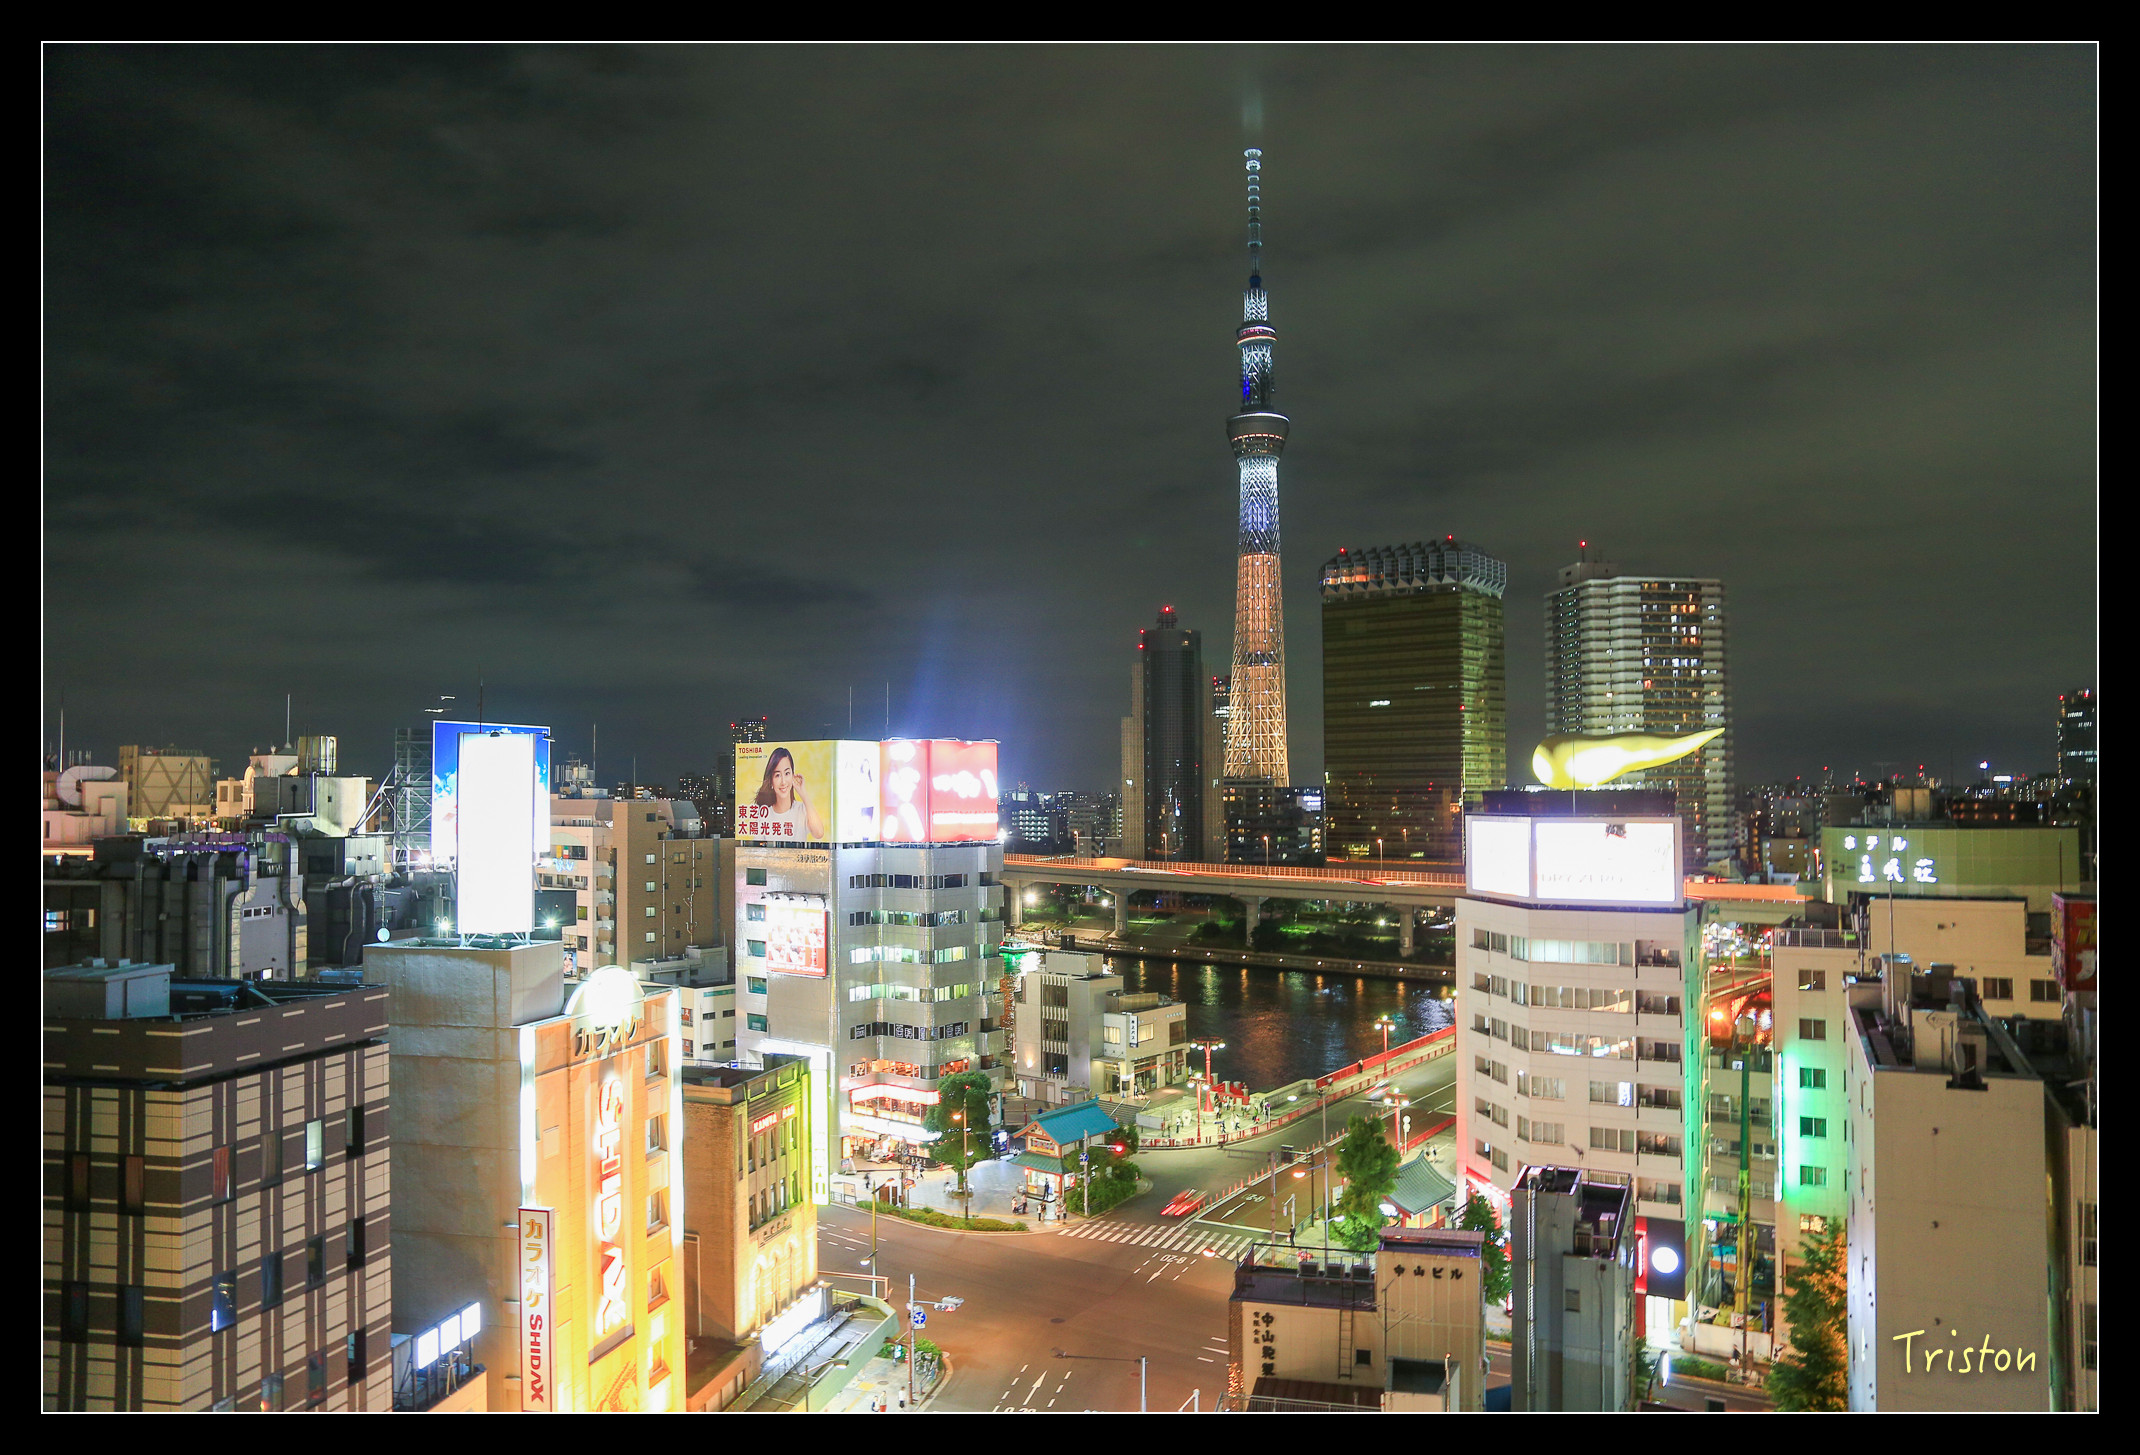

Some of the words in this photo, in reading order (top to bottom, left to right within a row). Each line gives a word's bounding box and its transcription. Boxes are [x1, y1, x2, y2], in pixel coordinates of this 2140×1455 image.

[738, 805, 769, 819] 東芝の
[738, 821, 794, 837] 太陽光発電
[1844, 835, 1908, 852] ホテル
[575, 1014, 640, 1057] カラオケ
[753, 1112, 778, 1133] KAMIYA
[782, 1103, 796, 1119] BAR
[599, 1079, 626, 1334] SHIDAX
[525, 1218, 545, 1308] カラオケ
[1393, 1264, 1463, 1281] 中山ビル
[529, 1314, 545, 1403] SHIDAX
